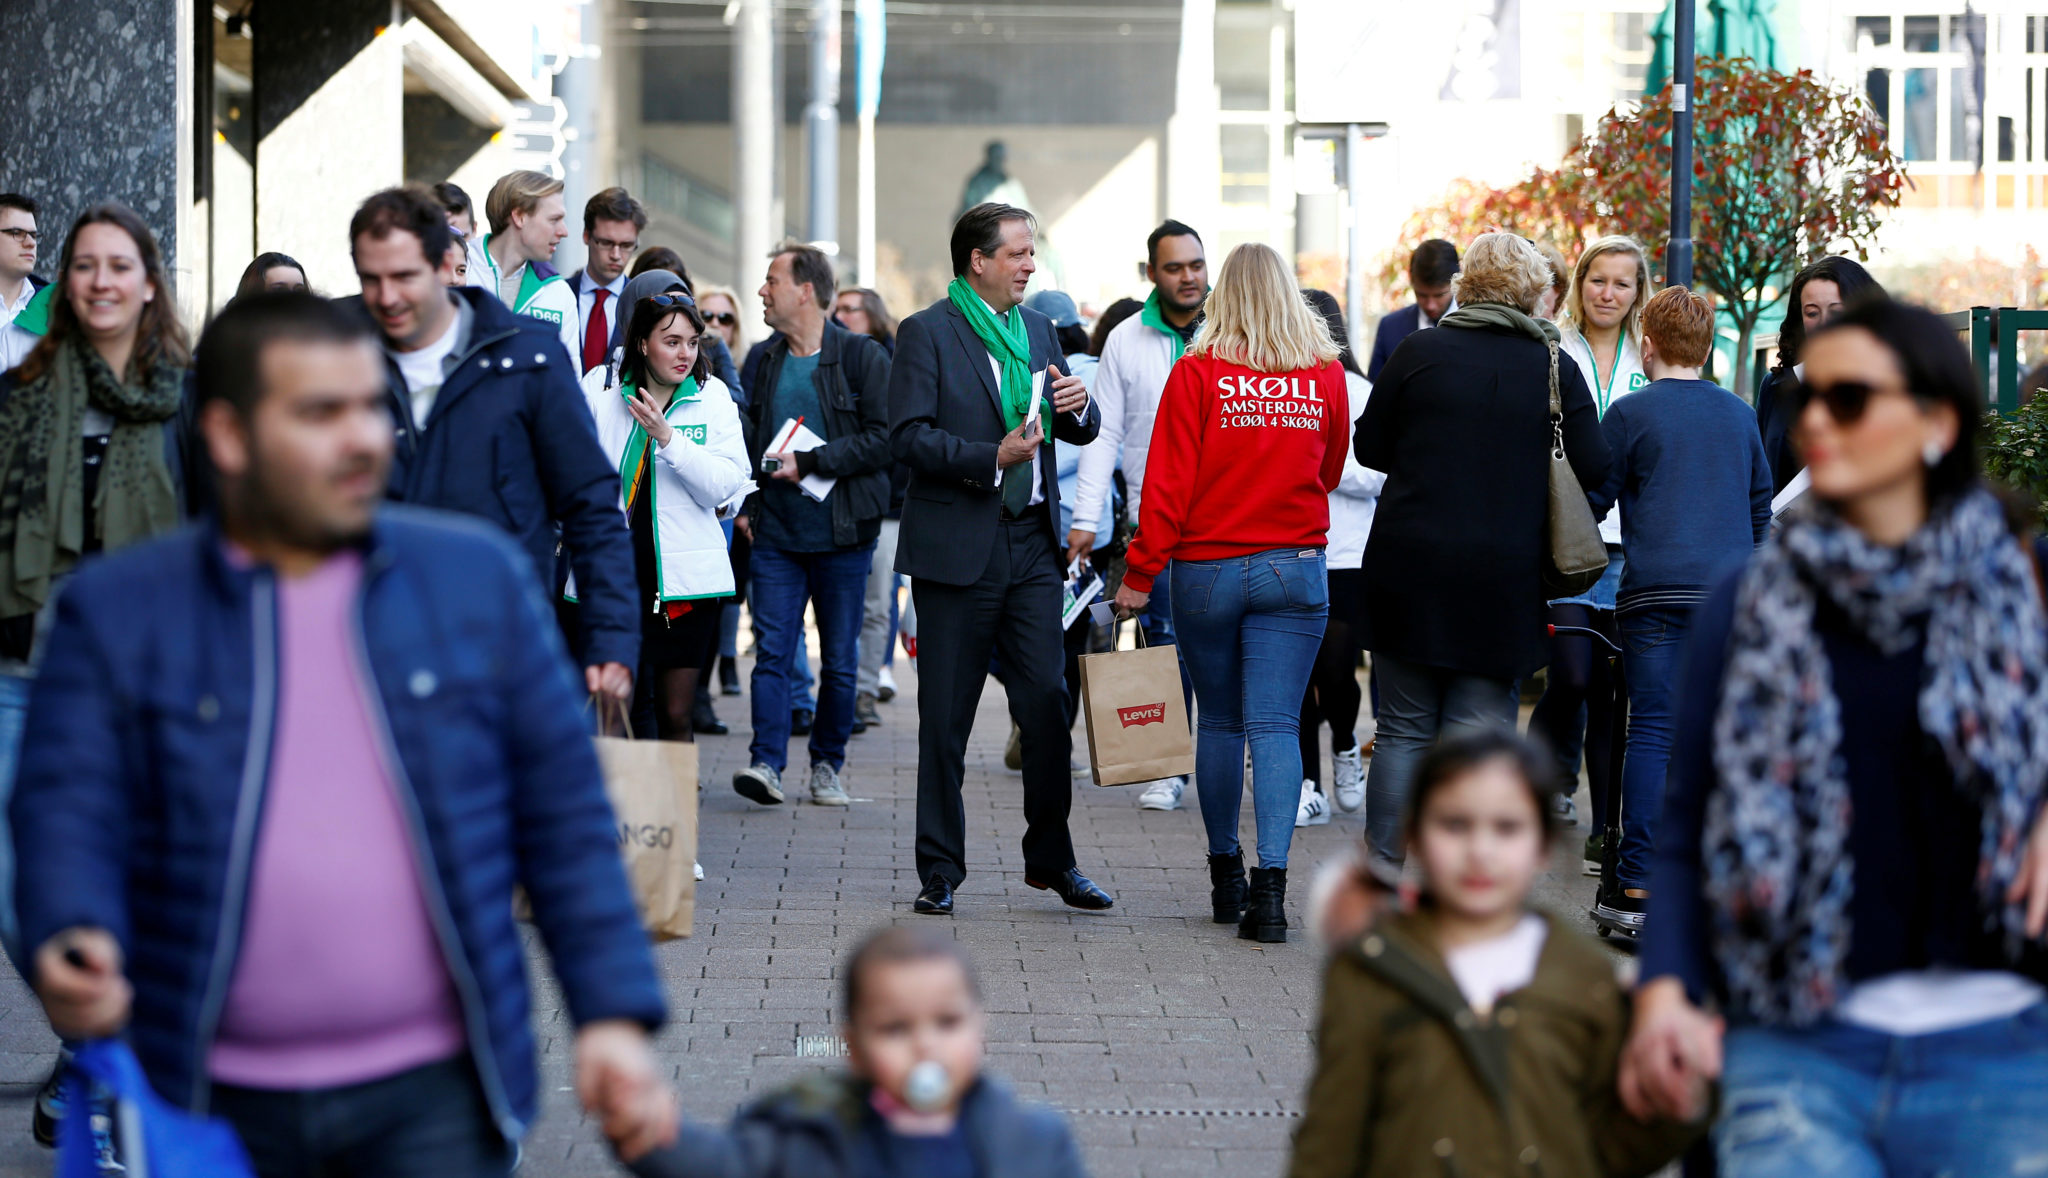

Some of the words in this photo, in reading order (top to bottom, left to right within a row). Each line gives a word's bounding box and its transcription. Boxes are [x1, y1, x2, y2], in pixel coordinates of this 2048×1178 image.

[532, 309, 561, 324] D66
[1217, 375, 1324, 402] SKØLL
[1220, 399, 1323, 418] AMSTERDAM
[1220, 417, 1228, 429] 2
[1231, 414, 1267, 427] CØØL
[1270, 416, 1278, 427] 4
[1281, 415, 1320, 431] SKØØL
